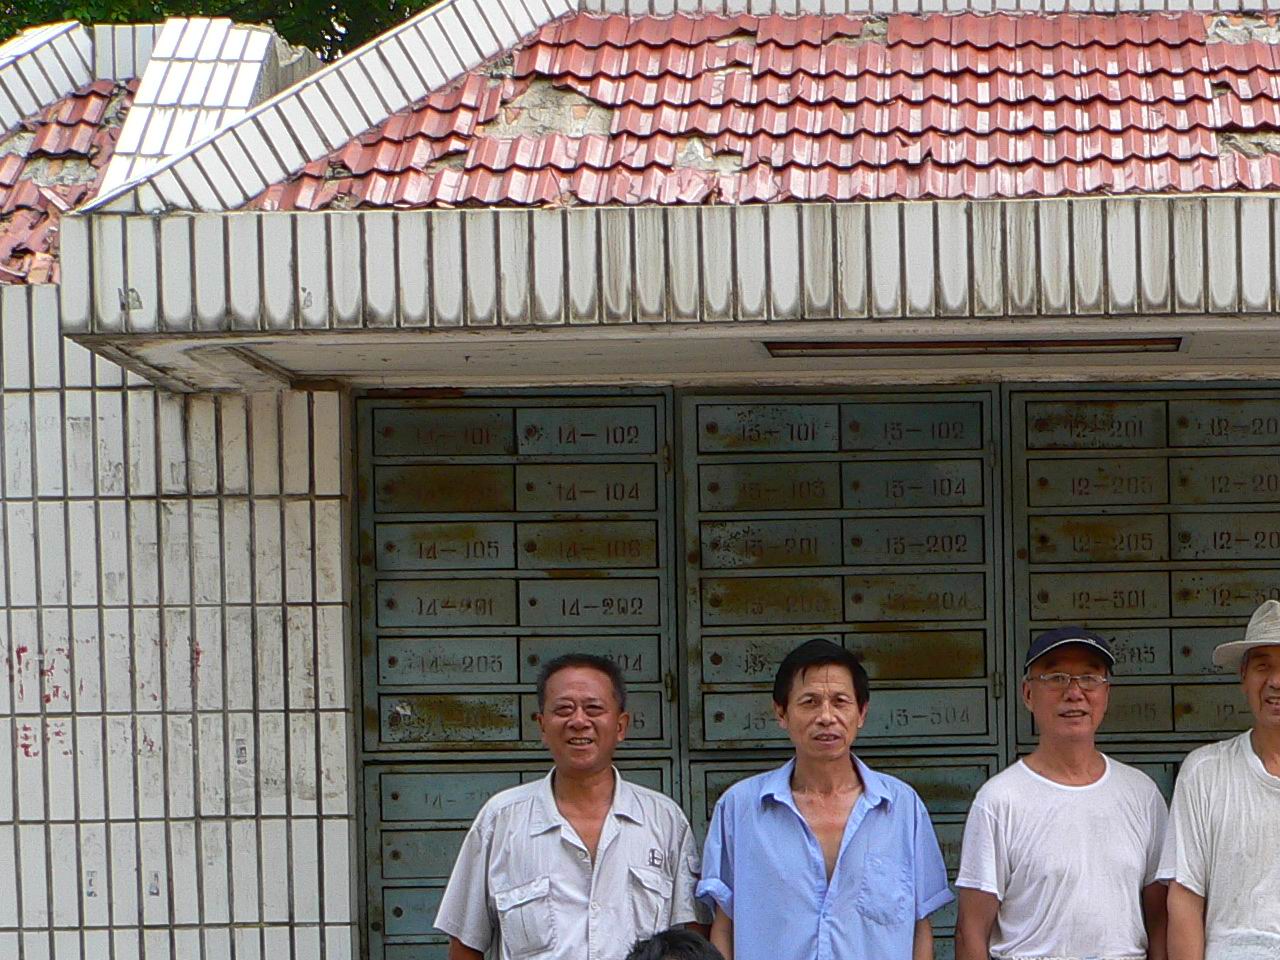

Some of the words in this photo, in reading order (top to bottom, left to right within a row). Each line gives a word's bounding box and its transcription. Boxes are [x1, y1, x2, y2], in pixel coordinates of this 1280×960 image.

[558, 425, 640, 445] 14-102
[557, 482, 640, 501] 14-104
[417, 540, 500, 560] 14-105
[886, 534, 968, 555] 15-202
[561, 597, 644, 616] 14-202
